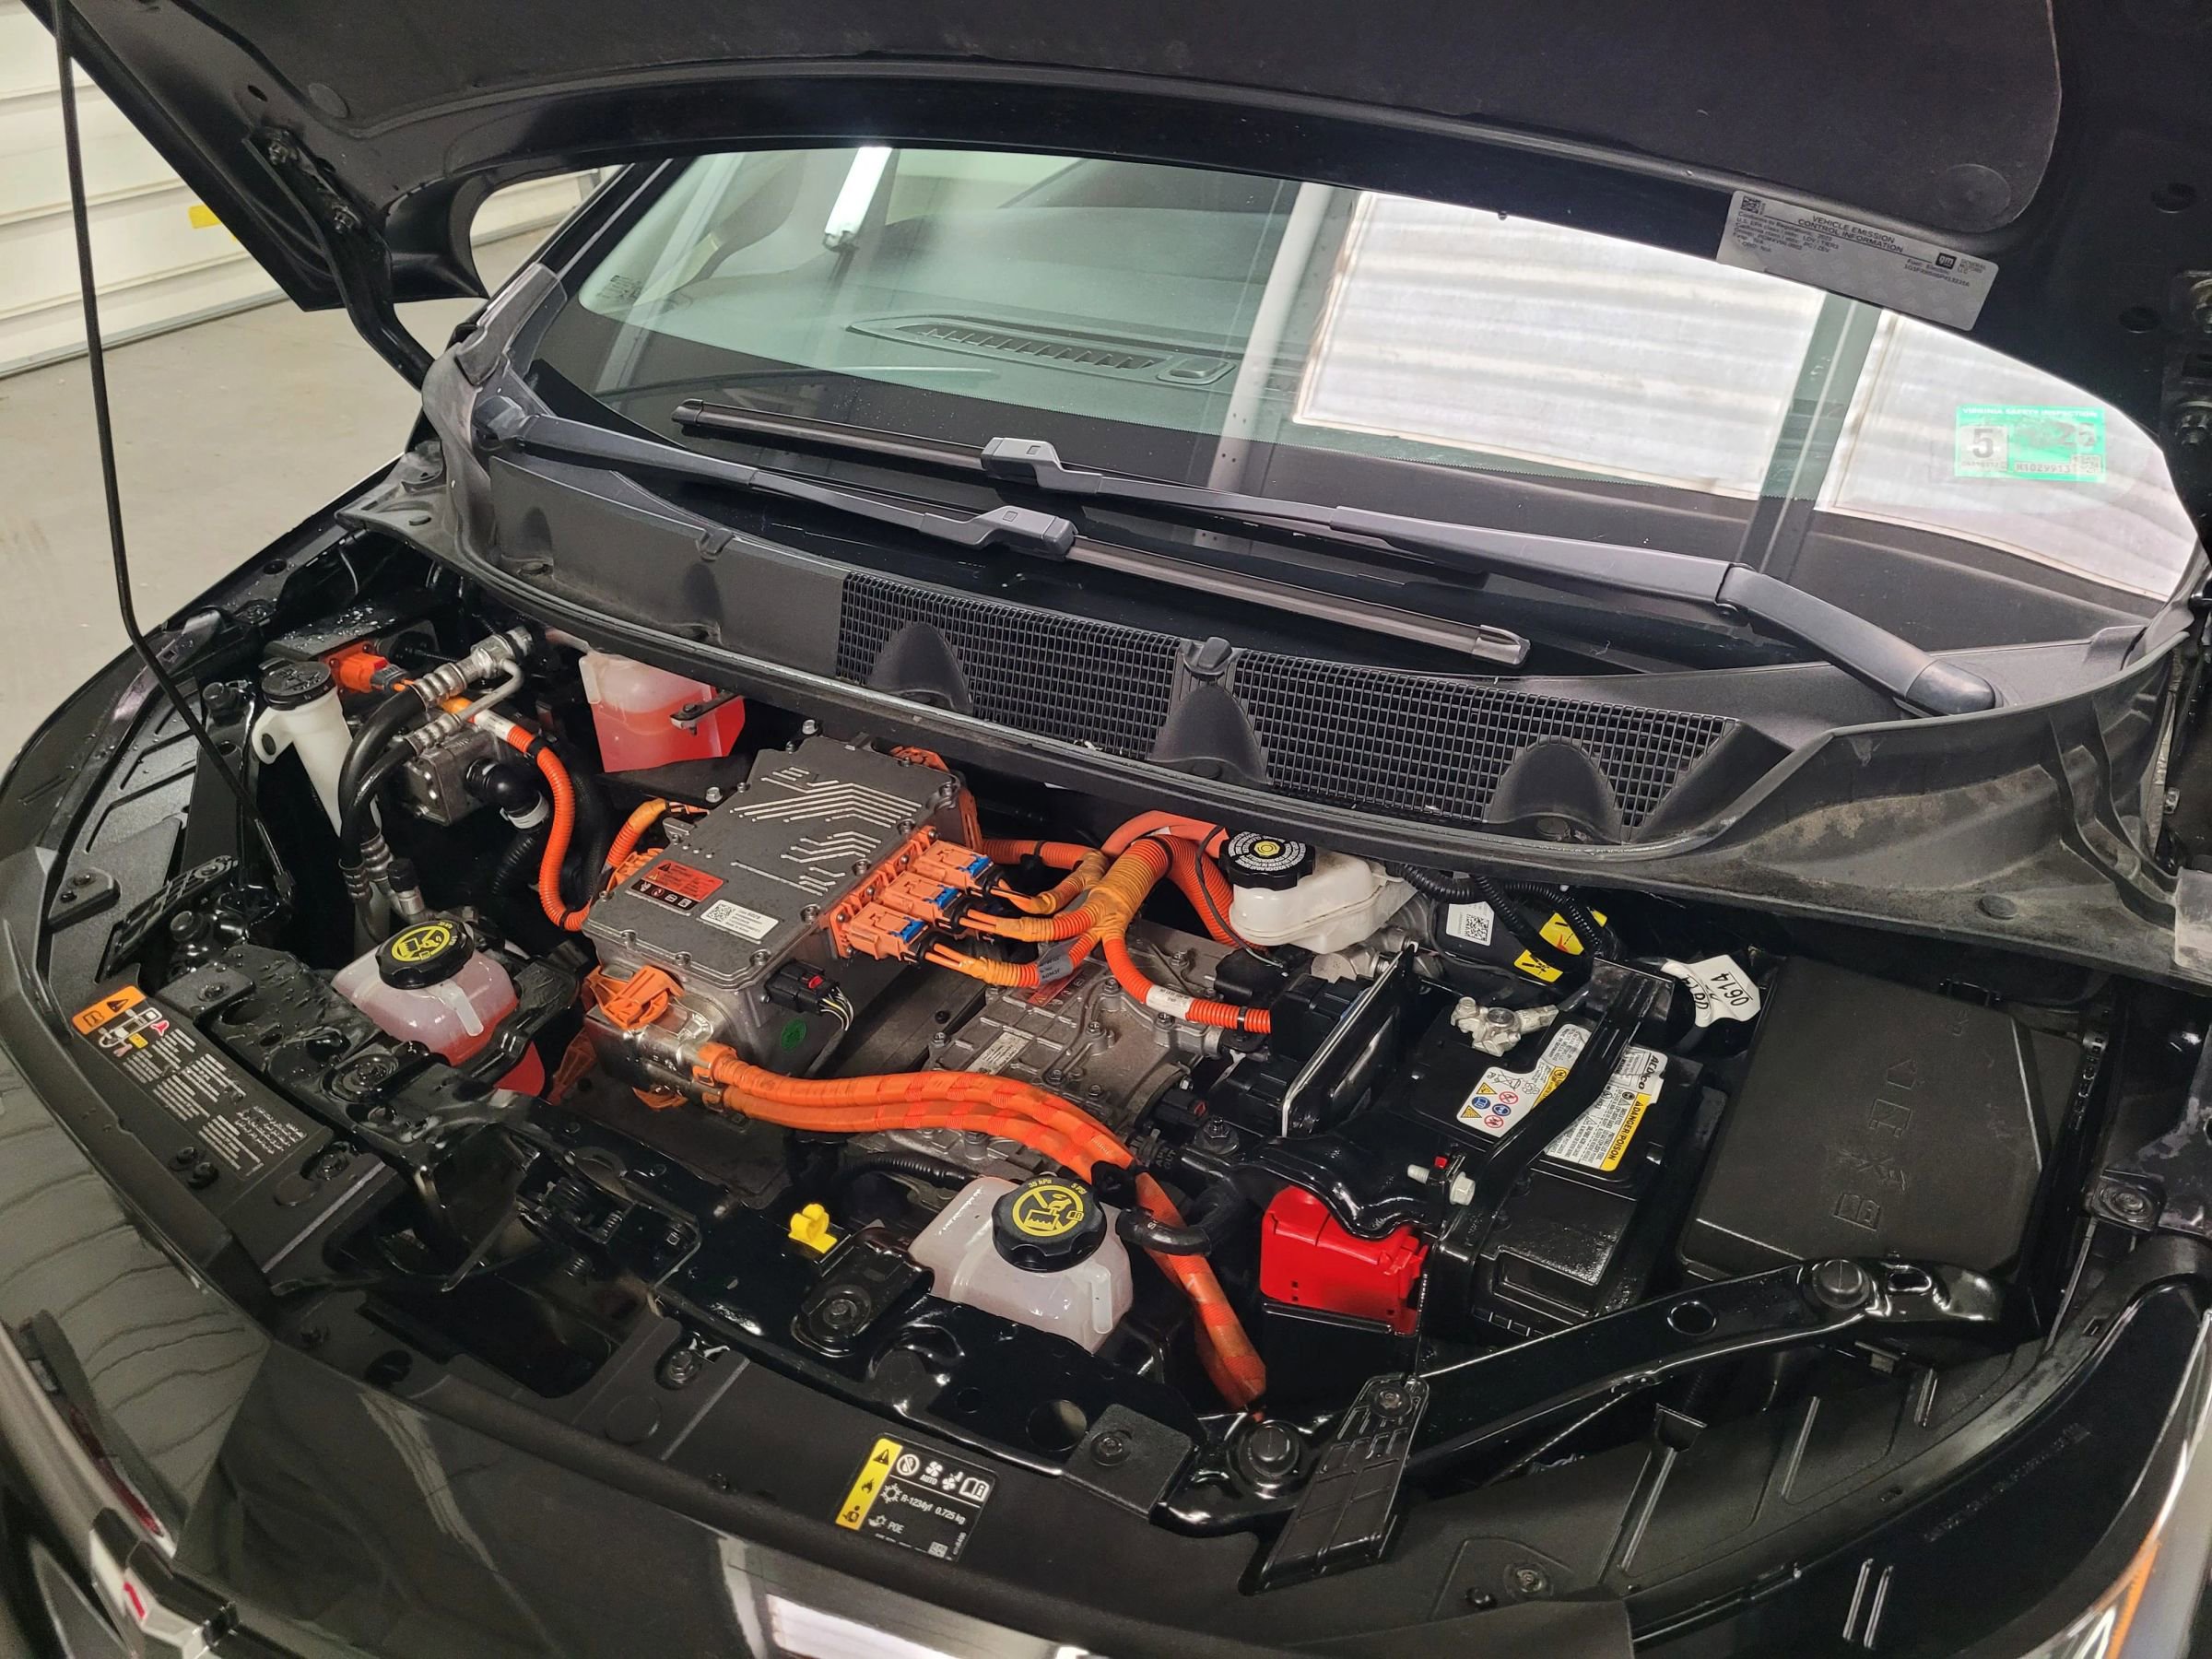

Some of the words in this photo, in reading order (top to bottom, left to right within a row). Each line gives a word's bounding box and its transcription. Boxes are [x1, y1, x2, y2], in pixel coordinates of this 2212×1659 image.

[1798, 218, 1841, 236] CONTROL
[1842, 231, 1903, 253] INFORMATION
[1813, 216, 1850, 231] VEHICLE
[1852, 227, 1895, 243] EMISSION
[2041, 409, 2099, 418] INSPECTION
[1971, 428, 1994, 459] 5
[1710, 972, 1750, 1006] 0614
[920, 1474, 938, 1486] AUTO
[900, 1494, 934, 1512] R-1234yf
[935, 1506, 957, 1521] 0.725
[956, 1512, 966, 1525] kg
